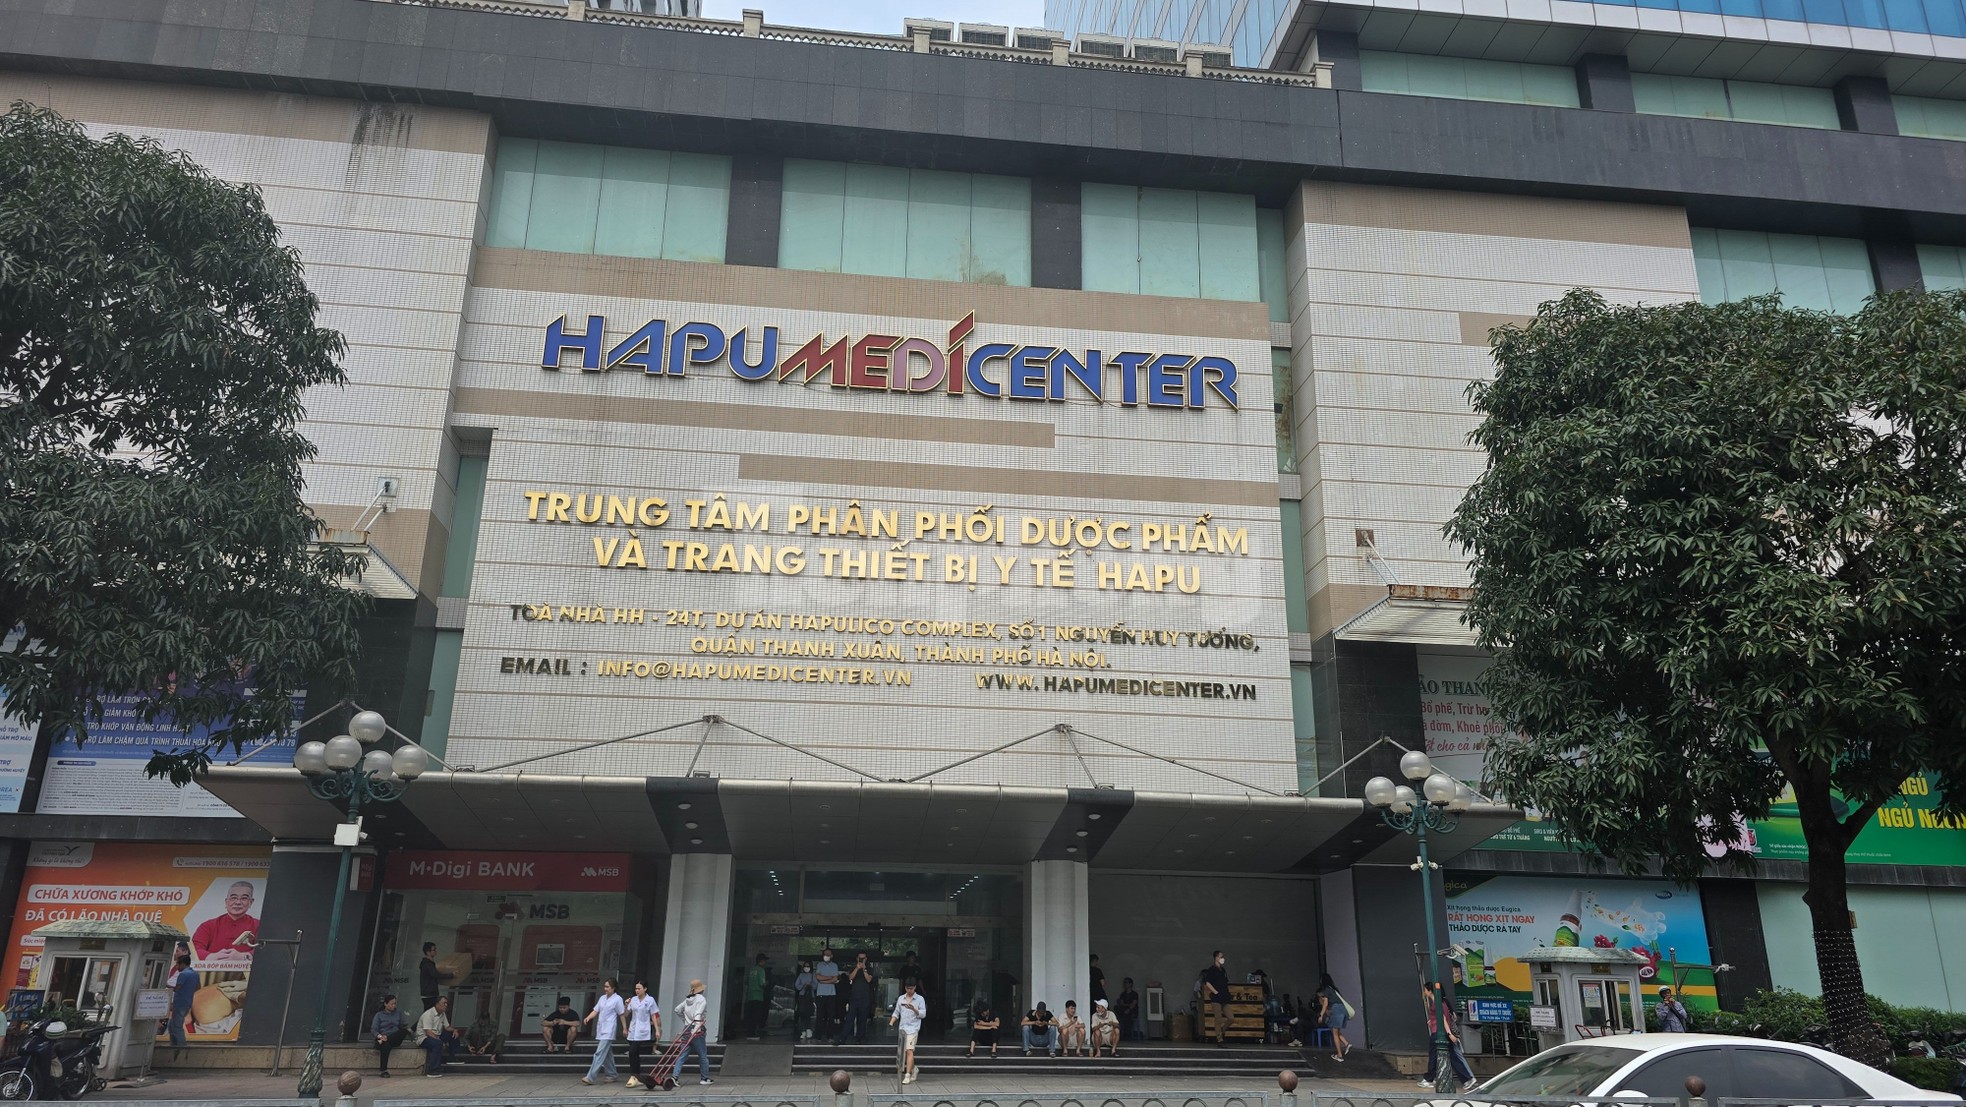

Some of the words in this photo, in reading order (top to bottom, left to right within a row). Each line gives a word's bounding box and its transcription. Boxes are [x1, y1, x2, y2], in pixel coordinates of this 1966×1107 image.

[524, 490, 671, 527] TRUNG
[685, 492, 770, 531] TÂM
[787, 499, 899, 538] PHÂN
[915, 504, 1004, 543] PHỐI
[1021, 515, 1132, 556] DƯỢC
[1141, 512, 1249, 556] PHẨM
[593, 530, 648, 569] VÀ
[662, 541, 807, 575] TRANG
[819, 538, 931, 581] THIẾT
[944, 554, 978, 591] BỊ
[993, 555, 1017, 585] Y
[1030, 549, 1076, 588] TẾ
[1097, 561, 1202, 594] HAPU
[510, 602, 553, 622] TOÀ
[560, 603, 606, 623] NHÀ
[613, 607, 645, 625] HH
[666, 609, 707, 630] 24T,
[715, 610, 745, 632] DỰ
[751, 609, 782, 630] ÁN
[789, 614, 894, 635] HAPULICO
[901, 620, 1002, 641] COMPLEX,
[1055, 621, 1136, 645] NGUYỄN
[1140, 629, 1180, 647] HUY
[690, 634, 755, 658] QUẬN
[762, 640, 835, 658] THANH
[843, 640, 906, 661] XUÂN,
[914, 642, 985, 664] THÀNH
[991, 643, 1032, 666] PHỐ
[1036, 647, 1064, 666] HÀ
[1069, 648, 1112, 672] NỘI.
[499, 657, 571, 676] EMAIL
[597, 660, 912, 686] INFO@HAPUMEDICENTER.VN
[1877, 802, 1915, 829] NGỦ
[478, 861, 535, 877] BANK
[598, 867, 619, 877] MSB
[34, 888, 68, 900] CHỮA
[72, 889, 117, 900] XƯƠNG
[119, 889, 154, 901] KHỚP
[156, 889, 183, 901] KHÓ
[25, 908, 45, 921] ĐÃ
[48, 909, 67, 922] CÓ
[101, 909, 130, 922] NHÀ
[529, 904, 570, 920] MSB
[1448, 911, 1464, 921] RÁT
[1467, 913, 1493, 924] HỌNG
[1495, 914, 1509, 924] XỊT
[1511, 915, 1535, 923] NGAY
[1449, 922, 1470, 931] THẢO
[1472, 924, 1494, 934] DƯỢC
[1508, 925, 1521, 933] TAY
[1244, 992, 1258, 1001] Tea
